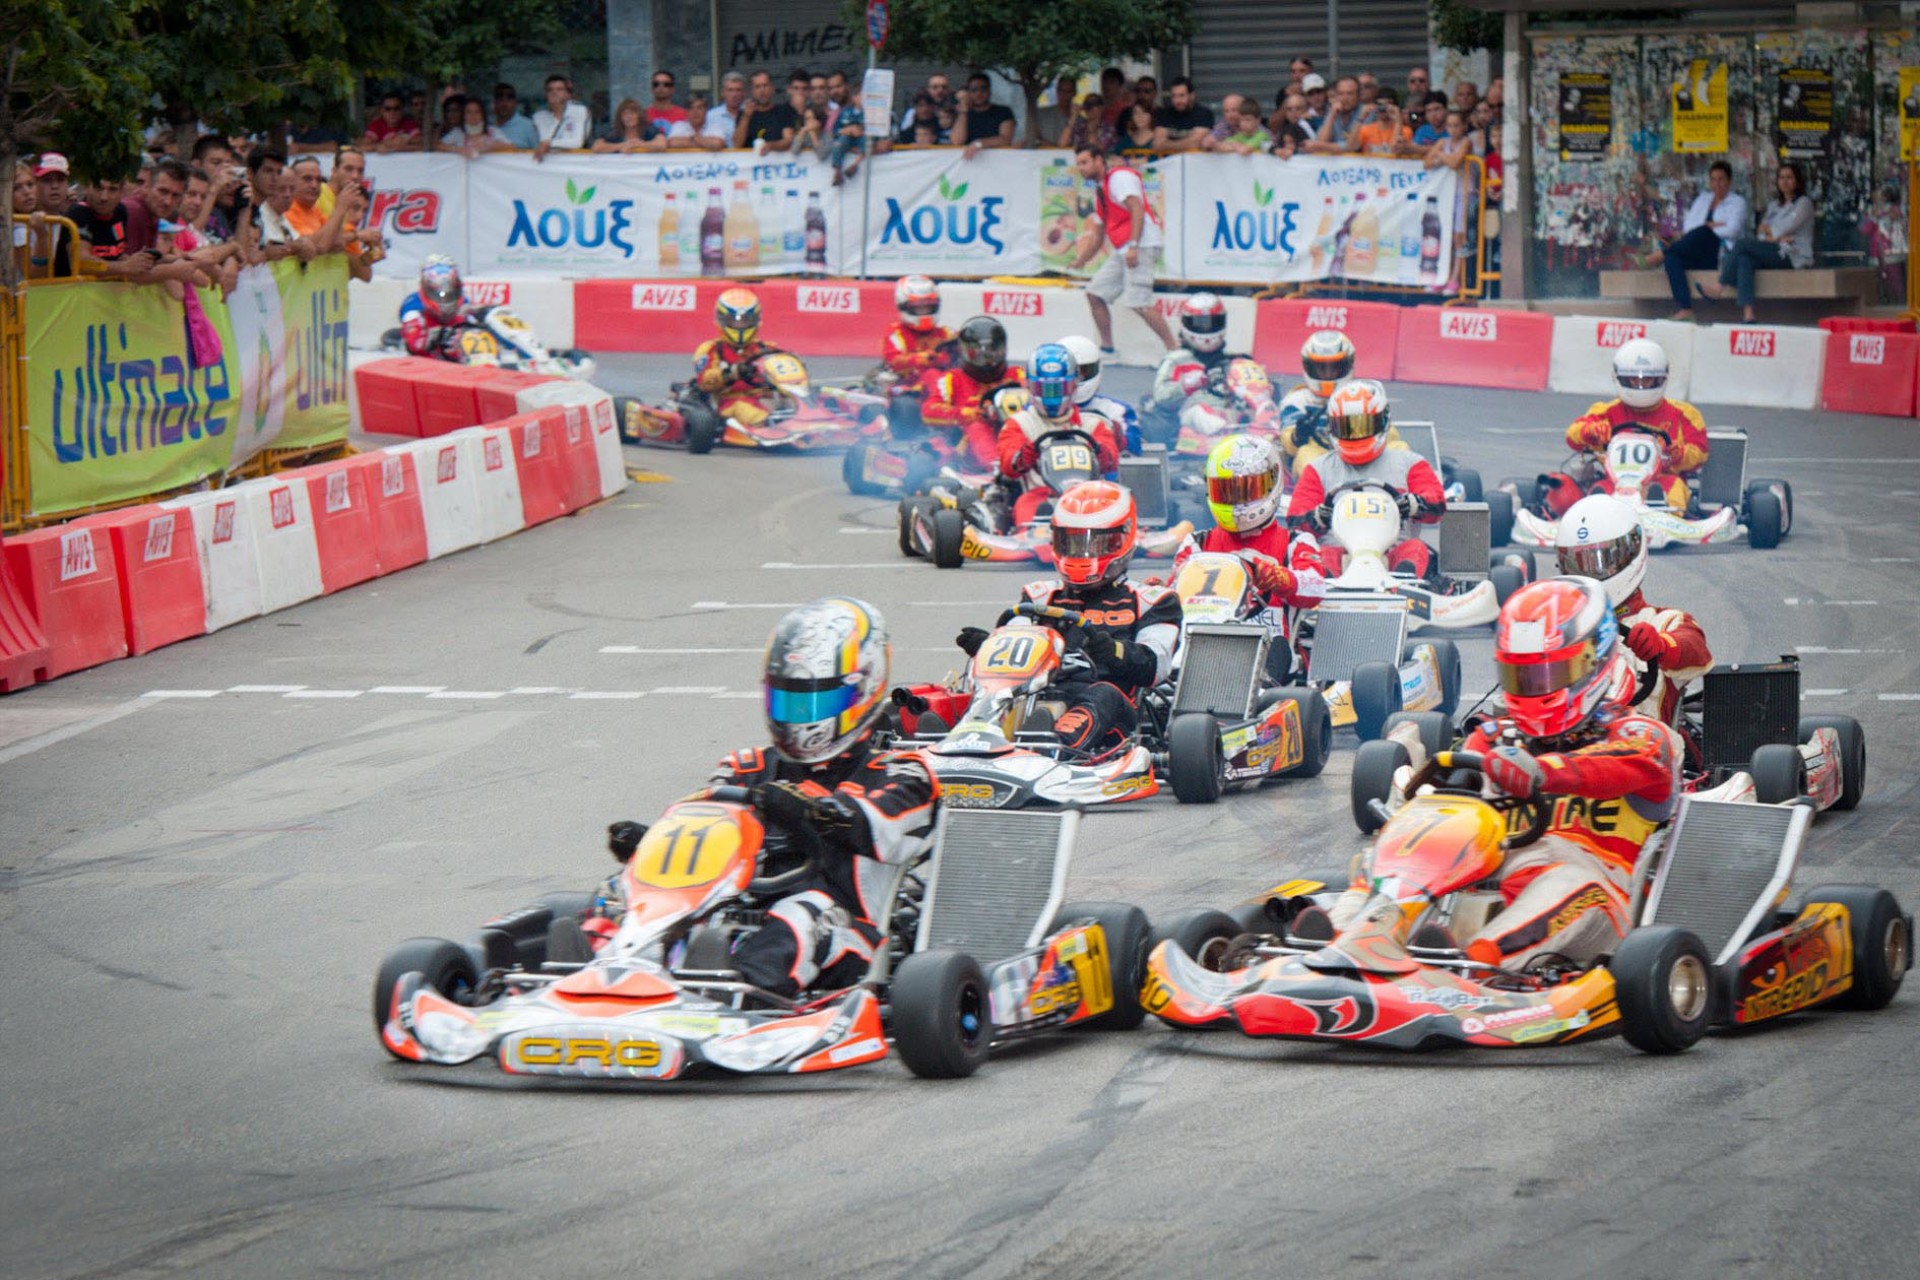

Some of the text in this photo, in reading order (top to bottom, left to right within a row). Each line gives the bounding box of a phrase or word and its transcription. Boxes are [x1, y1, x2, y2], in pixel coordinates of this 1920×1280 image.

[507, 199, 634, 258] λουξ
[880, 196, 1004, 256] λουξ
[1212, 200, 1300, 263] λουξ
[640, 288, 688, 306] AVIS
[805, 290, 853, 309] AVIS
[987, 292, 1038, 315] AVIS
[1305, 306, 1348, 329] AVIS
[1449, 316, 1490, 337] AVIS
[1600, 322, 1641, 347] AVIS
[1734, 333, 1771, 356] AVIS
[1854, 336, 1883, 361] AVIS
[1055, 450, 1087, 466] 29
[1615, 443, 1651, 465] 10
[1351, 497, 1380, 514] 15
[64, 534, 91, 575] AVIS
[1195, 568, 1221, 596] 1
[988, 636, 1035, 668] 20
[1101, 775, 1153, 796] CRG
[658, 824, 712, 876] 11
[1030, 981, 1080, 1015] CRG
[517, 1038, 662, 1068] CRG
